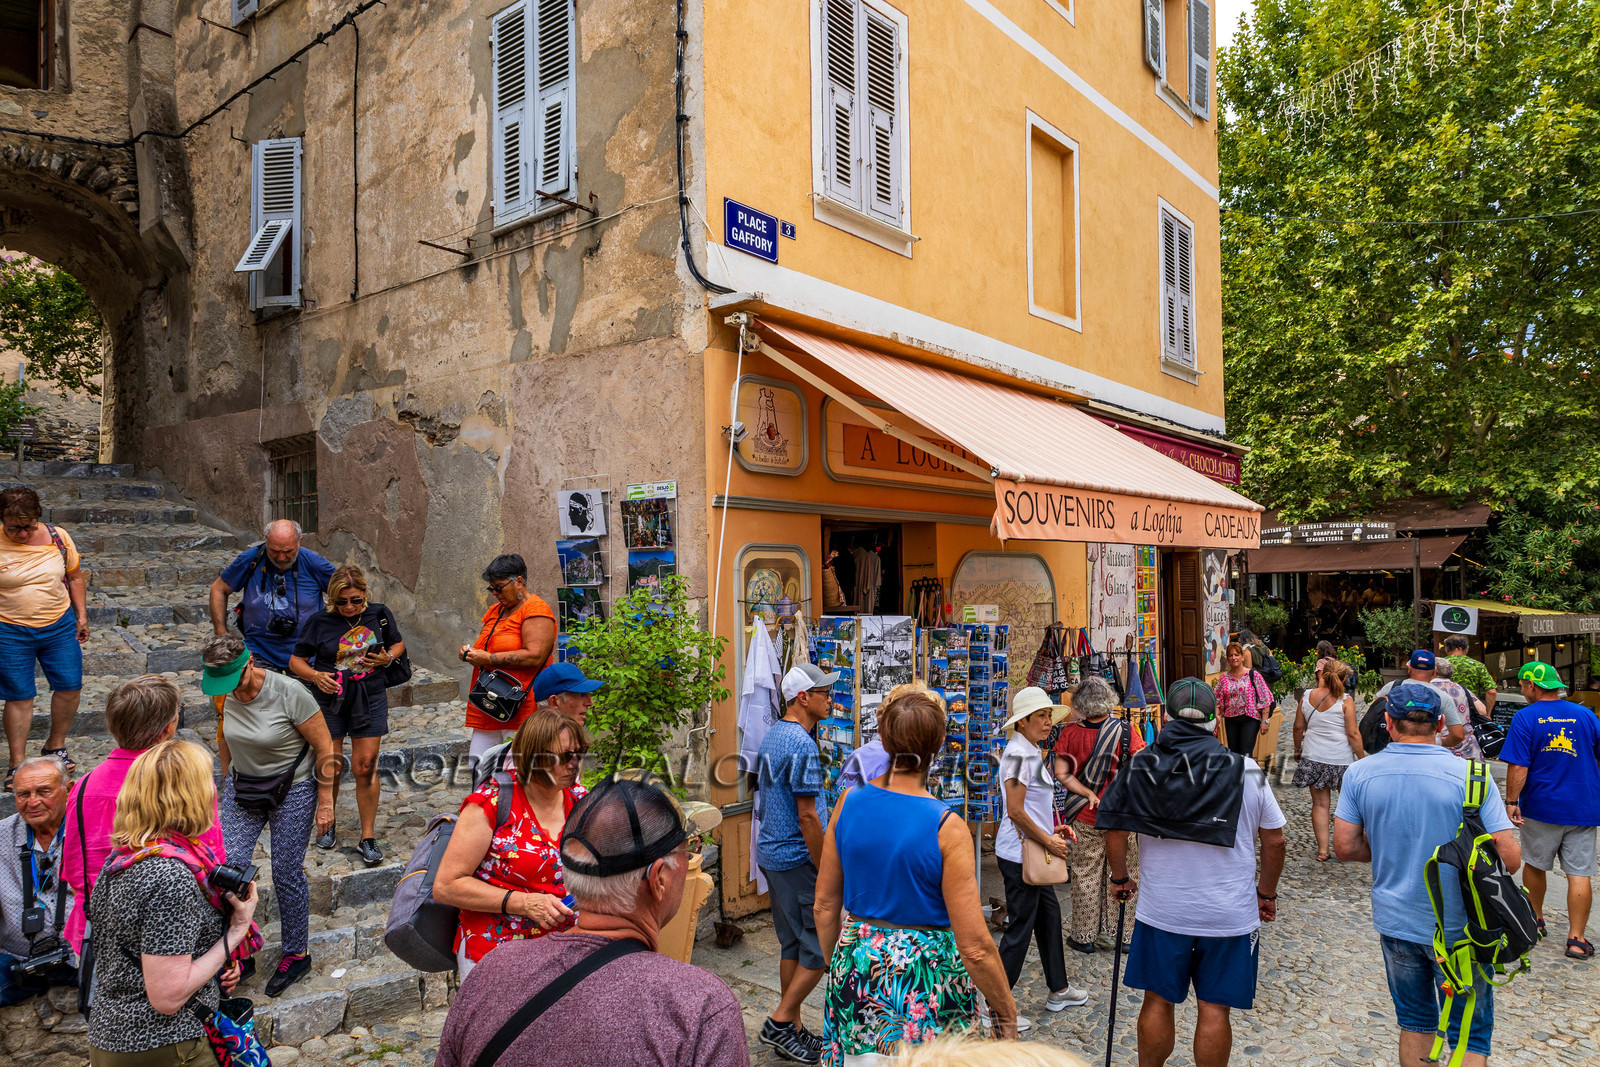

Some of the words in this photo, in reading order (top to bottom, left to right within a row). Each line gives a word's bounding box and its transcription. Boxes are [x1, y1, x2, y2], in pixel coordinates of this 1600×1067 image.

[738, 211, 767, 233] PLACE
[785, 224, 791, 236] 3
[731, 227, 773, 253] GAFFORY
[860, 431, 876, 462] A
[1189, 453, 1238, 478] CHOCOLATIER
[1004, 489, 1115, 529] SOUVENIRS
[1130, 510, 1138, 531] a
[1142, 503, 1183, 543] Loghja
[1204, 512, 1259, 540] CADEAUX
[1261, 526, 1291, 534] RESTAURANT
[1532, 618, 1555, 634] GLACIER
